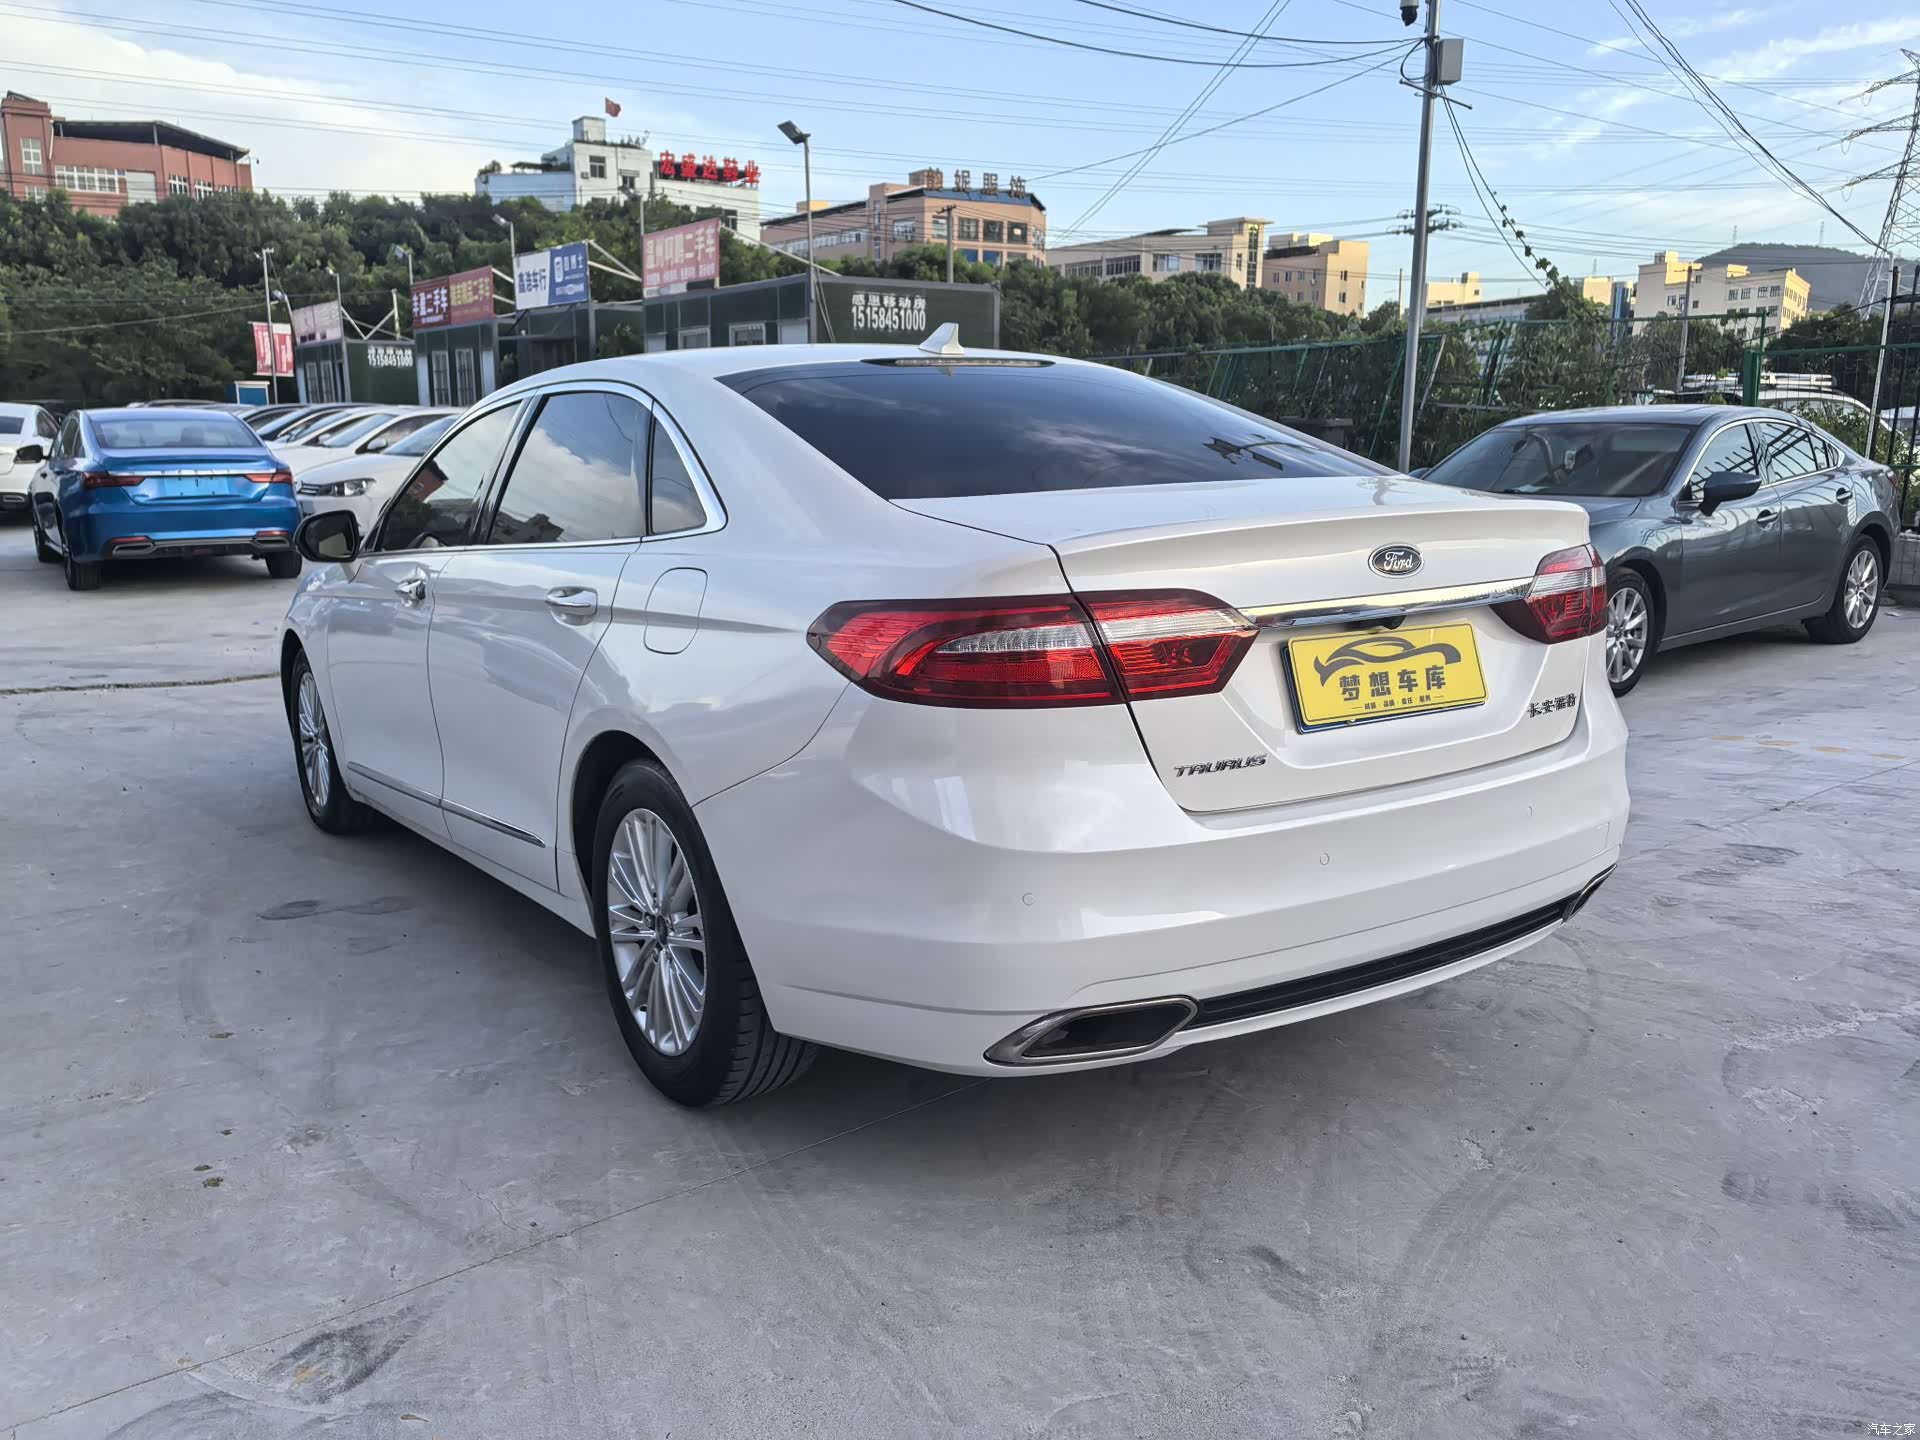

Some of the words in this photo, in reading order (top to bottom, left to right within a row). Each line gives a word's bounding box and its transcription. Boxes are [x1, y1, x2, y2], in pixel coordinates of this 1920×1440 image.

[851, 292, 926, 310] 感恩移动房
[851, 305, 927, 332] 15158451000
[1383, 550, 1414, 571] Ford
[1339, 664, 1446, 702] 梦想车库
[1173, 753, 1267, 777] TAURUS
